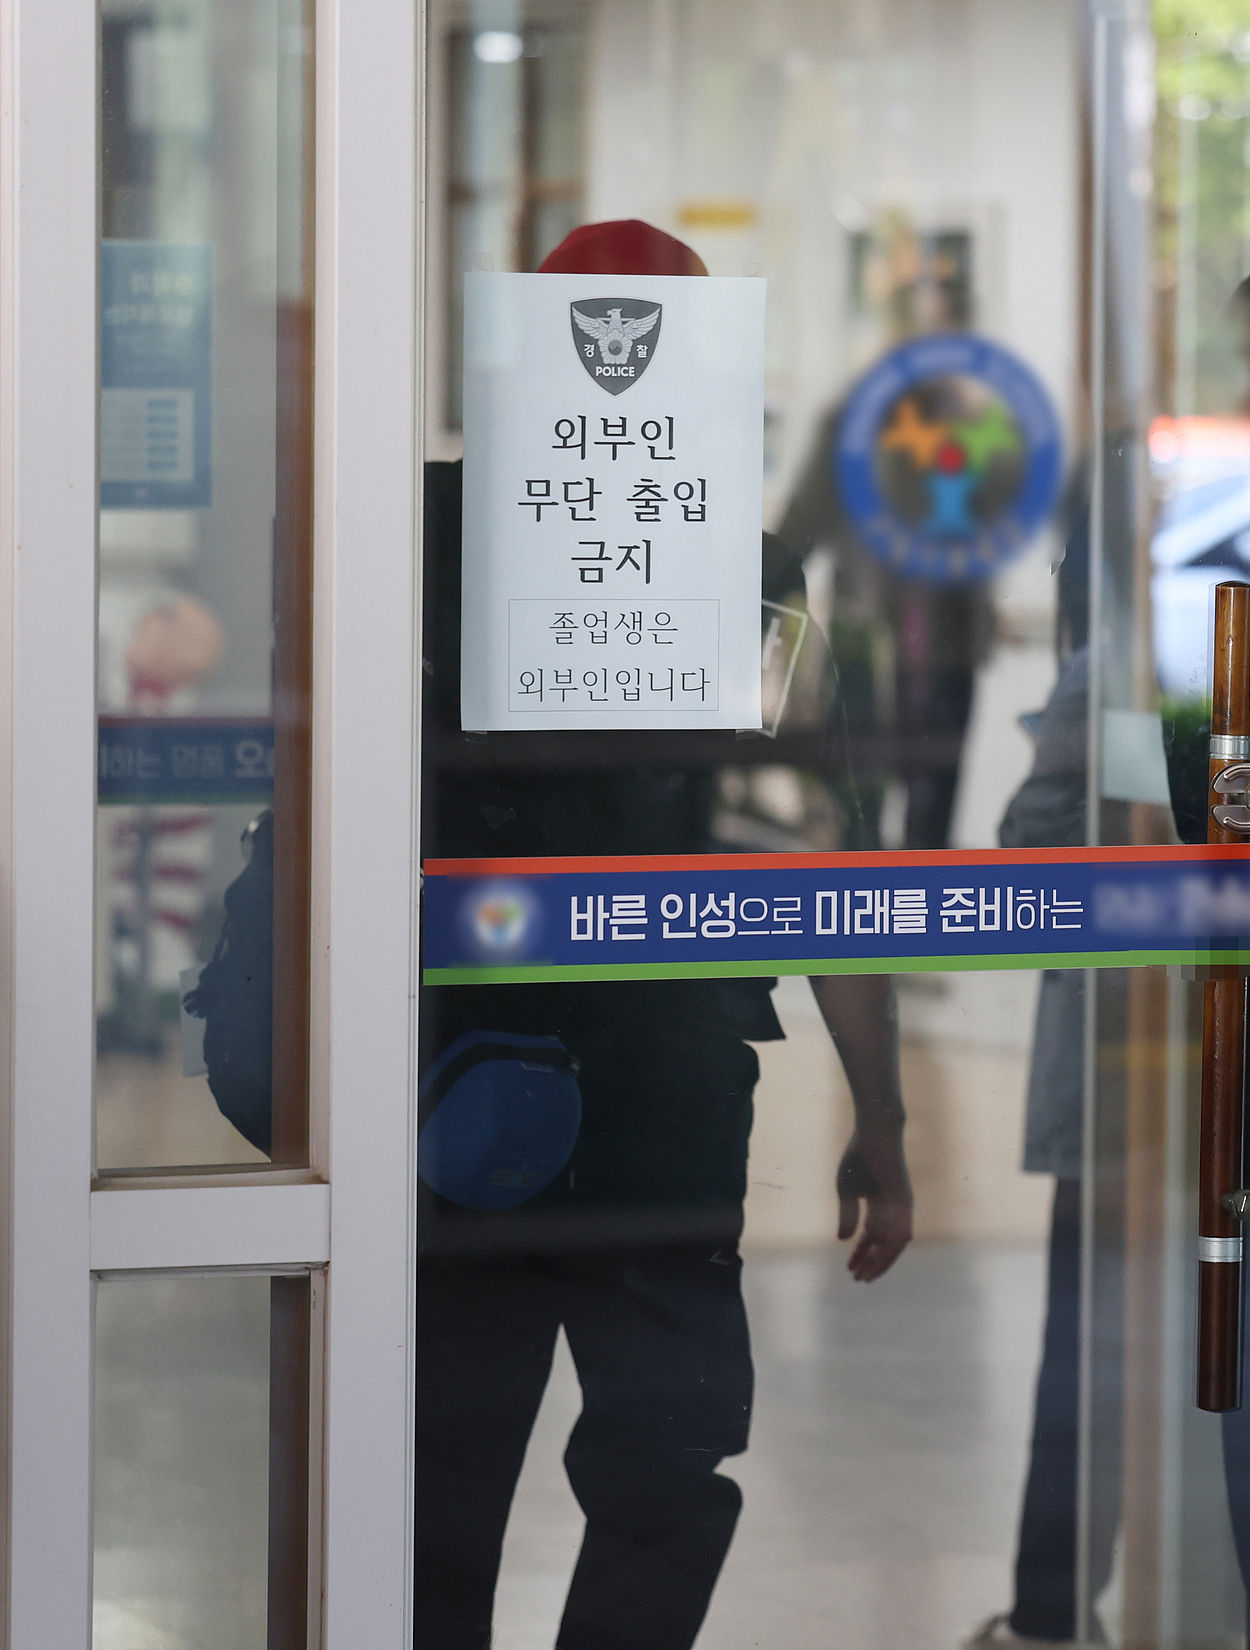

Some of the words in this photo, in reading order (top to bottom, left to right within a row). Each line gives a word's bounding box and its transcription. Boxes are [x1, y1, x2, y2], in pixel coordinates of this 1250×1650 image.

[584, 343, 595, 358] 경
[636, 343, 648, 359] 찰
[594, 366, 636, 378] POLICE
[552, 415, 677, 461] 외부인
[518, 477, 602, 523] 무단
[626, 477, 707, 523] 출입
[570, 539, 651, 584] 금지
[549, 611, 679, 645] 졸업생은
[517, 667, 711, 702] 외부인입니다
[570, 893, 647, 941] 바른
[660, 890, 803, 939] 인성으로
[815, 888, 929, 937] 미래를
[939, 886, 1084, 934] 준비하는
